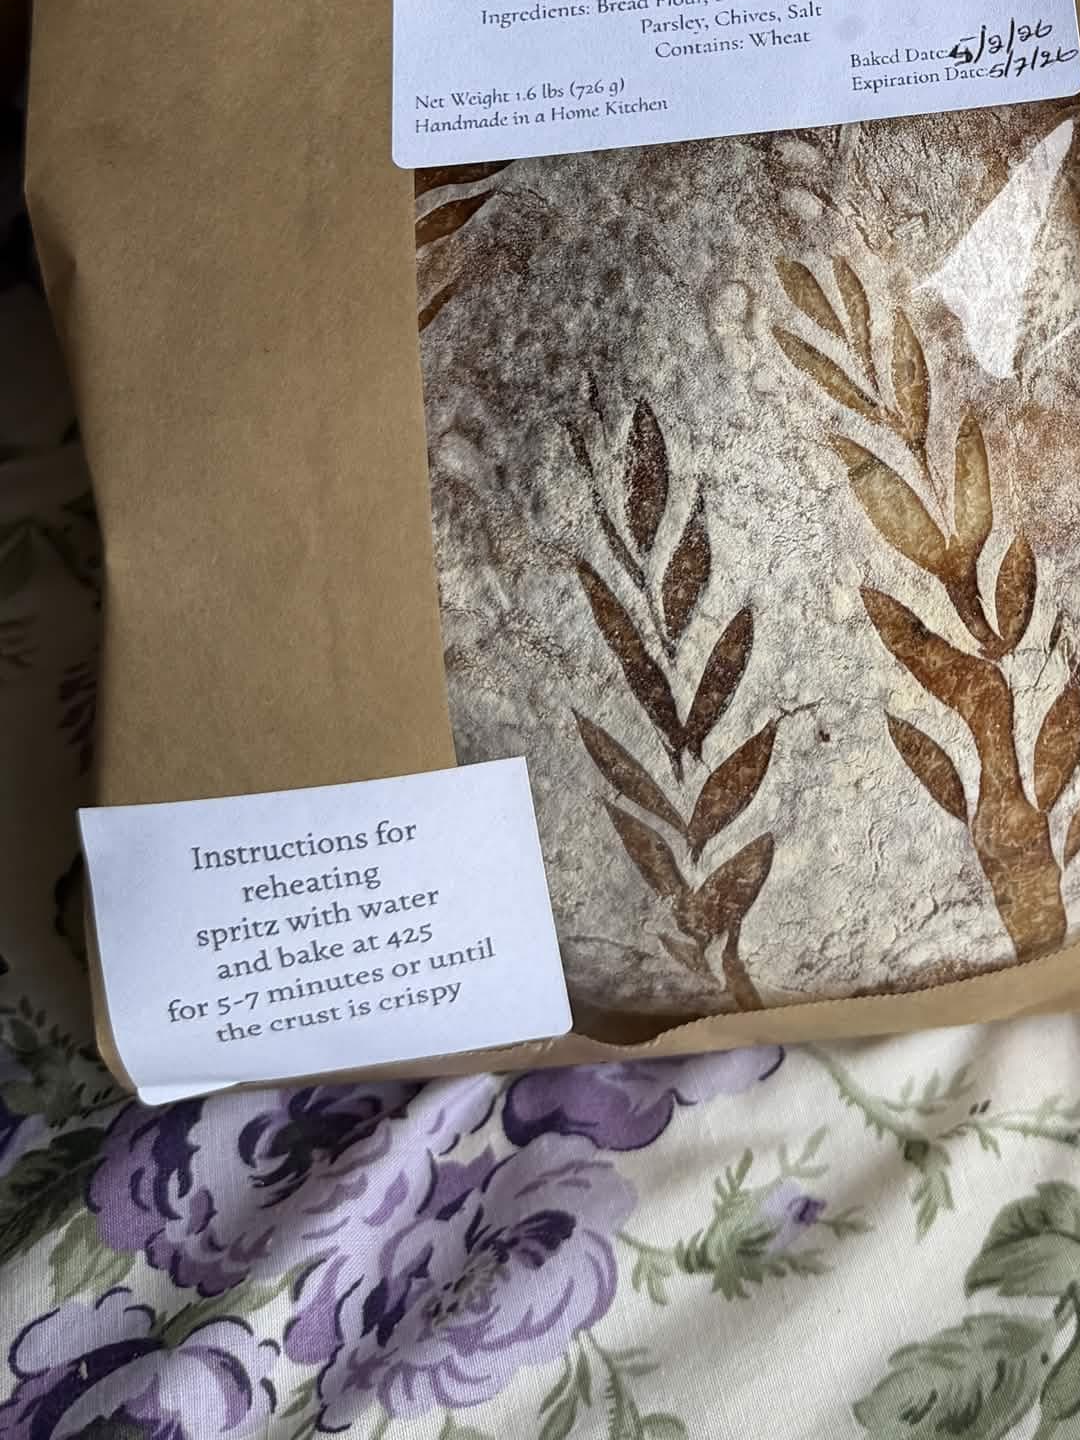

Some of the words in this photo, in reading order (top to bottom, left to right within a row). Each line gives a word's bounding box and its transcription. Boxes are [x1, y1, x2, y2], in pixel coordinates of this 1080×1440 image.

[481, 3, 592, 29] Ingredients:
[639, 14, 710, 38] Parsley,
[714, 7, 783, 29] Chives,
[787, 1, 823, 20] Salt
[655, 35, 746, 60] Contains:
[749, 28, 812, 50] Wheat
[850, 49, 901, 68] Baked
[415, 94, 446, 111] Net
[451, 86, 511, 111] Weight
[515, 85, 537, 103] 1.6
[542, 82, 565, 100] lbs
[569, 79, 605, 101] (726
[608, 76, 626, 98] g)
[851, 72, 940, 95] Expiration
[944, 66, 990, 83] Date:
[415, 110, 509, 134] Handmade
[512, 112, 531, 126] in
[534, 113, 546, 124] a
[550, 104, 601, 123] Home
[605, 97, 669, 117] Kitchen
[191, 831, 370, 871] Instructions
[375, 820, 418, 848] for
[241, 864, 382, 904] reheating
[195, 914, 281, 953] spritz
[285, 900, 352, 935] with
[357, 887, 441, 922] water
[215, 947, 273, 981] and
[276, 938, 346, 971] bake
[351, 934, 381, 956] at
[386, 922, 435, 950] 425
[167, 998, 210, 1024] for
[215, 990, 261, 1017] 5-7
[265, 964, 386, 1005] minutes
[390, 960, 423, 979] or
[427, 936, 498, 972] until
[214, 1021, 265, 1044] the
[268, 1004, 344, 1034] crust
[348, 998, 374, 1020] is
[378, 980, 464, 1013] crispy
